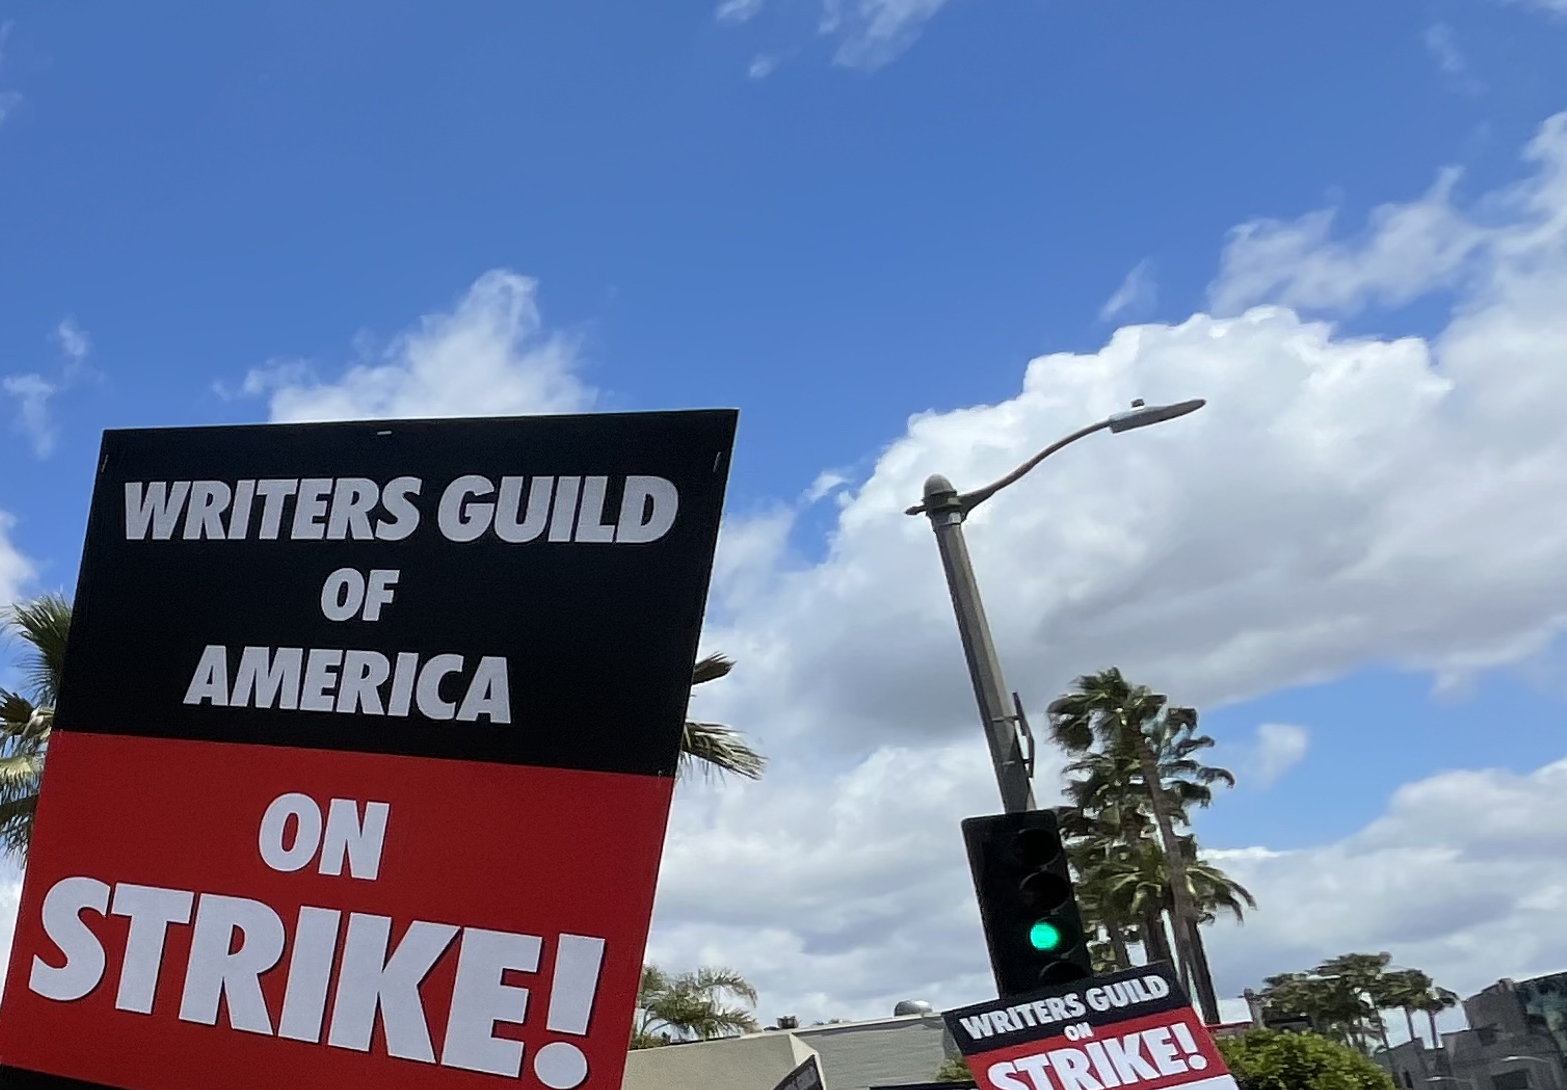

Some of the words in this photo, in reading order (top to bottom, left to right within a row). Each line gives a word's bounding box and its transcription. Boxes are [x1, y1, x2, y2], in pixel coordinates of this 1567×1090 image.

[124, 476, 422, 541] WRITERS
[437, 474, 680, 544] GUILD
[320, 567, 400, 622] OF
[183, 644, 512, 724] AMERICA
[258, 792, 391, 881] ON
[28, 875, 606, 1090] STRIKE!
[959, 992, 1085, 1040] WRITERS
[1086, 975, 1170, 1013] GUILD
[1064, 1022, 1093, 1041] ON
